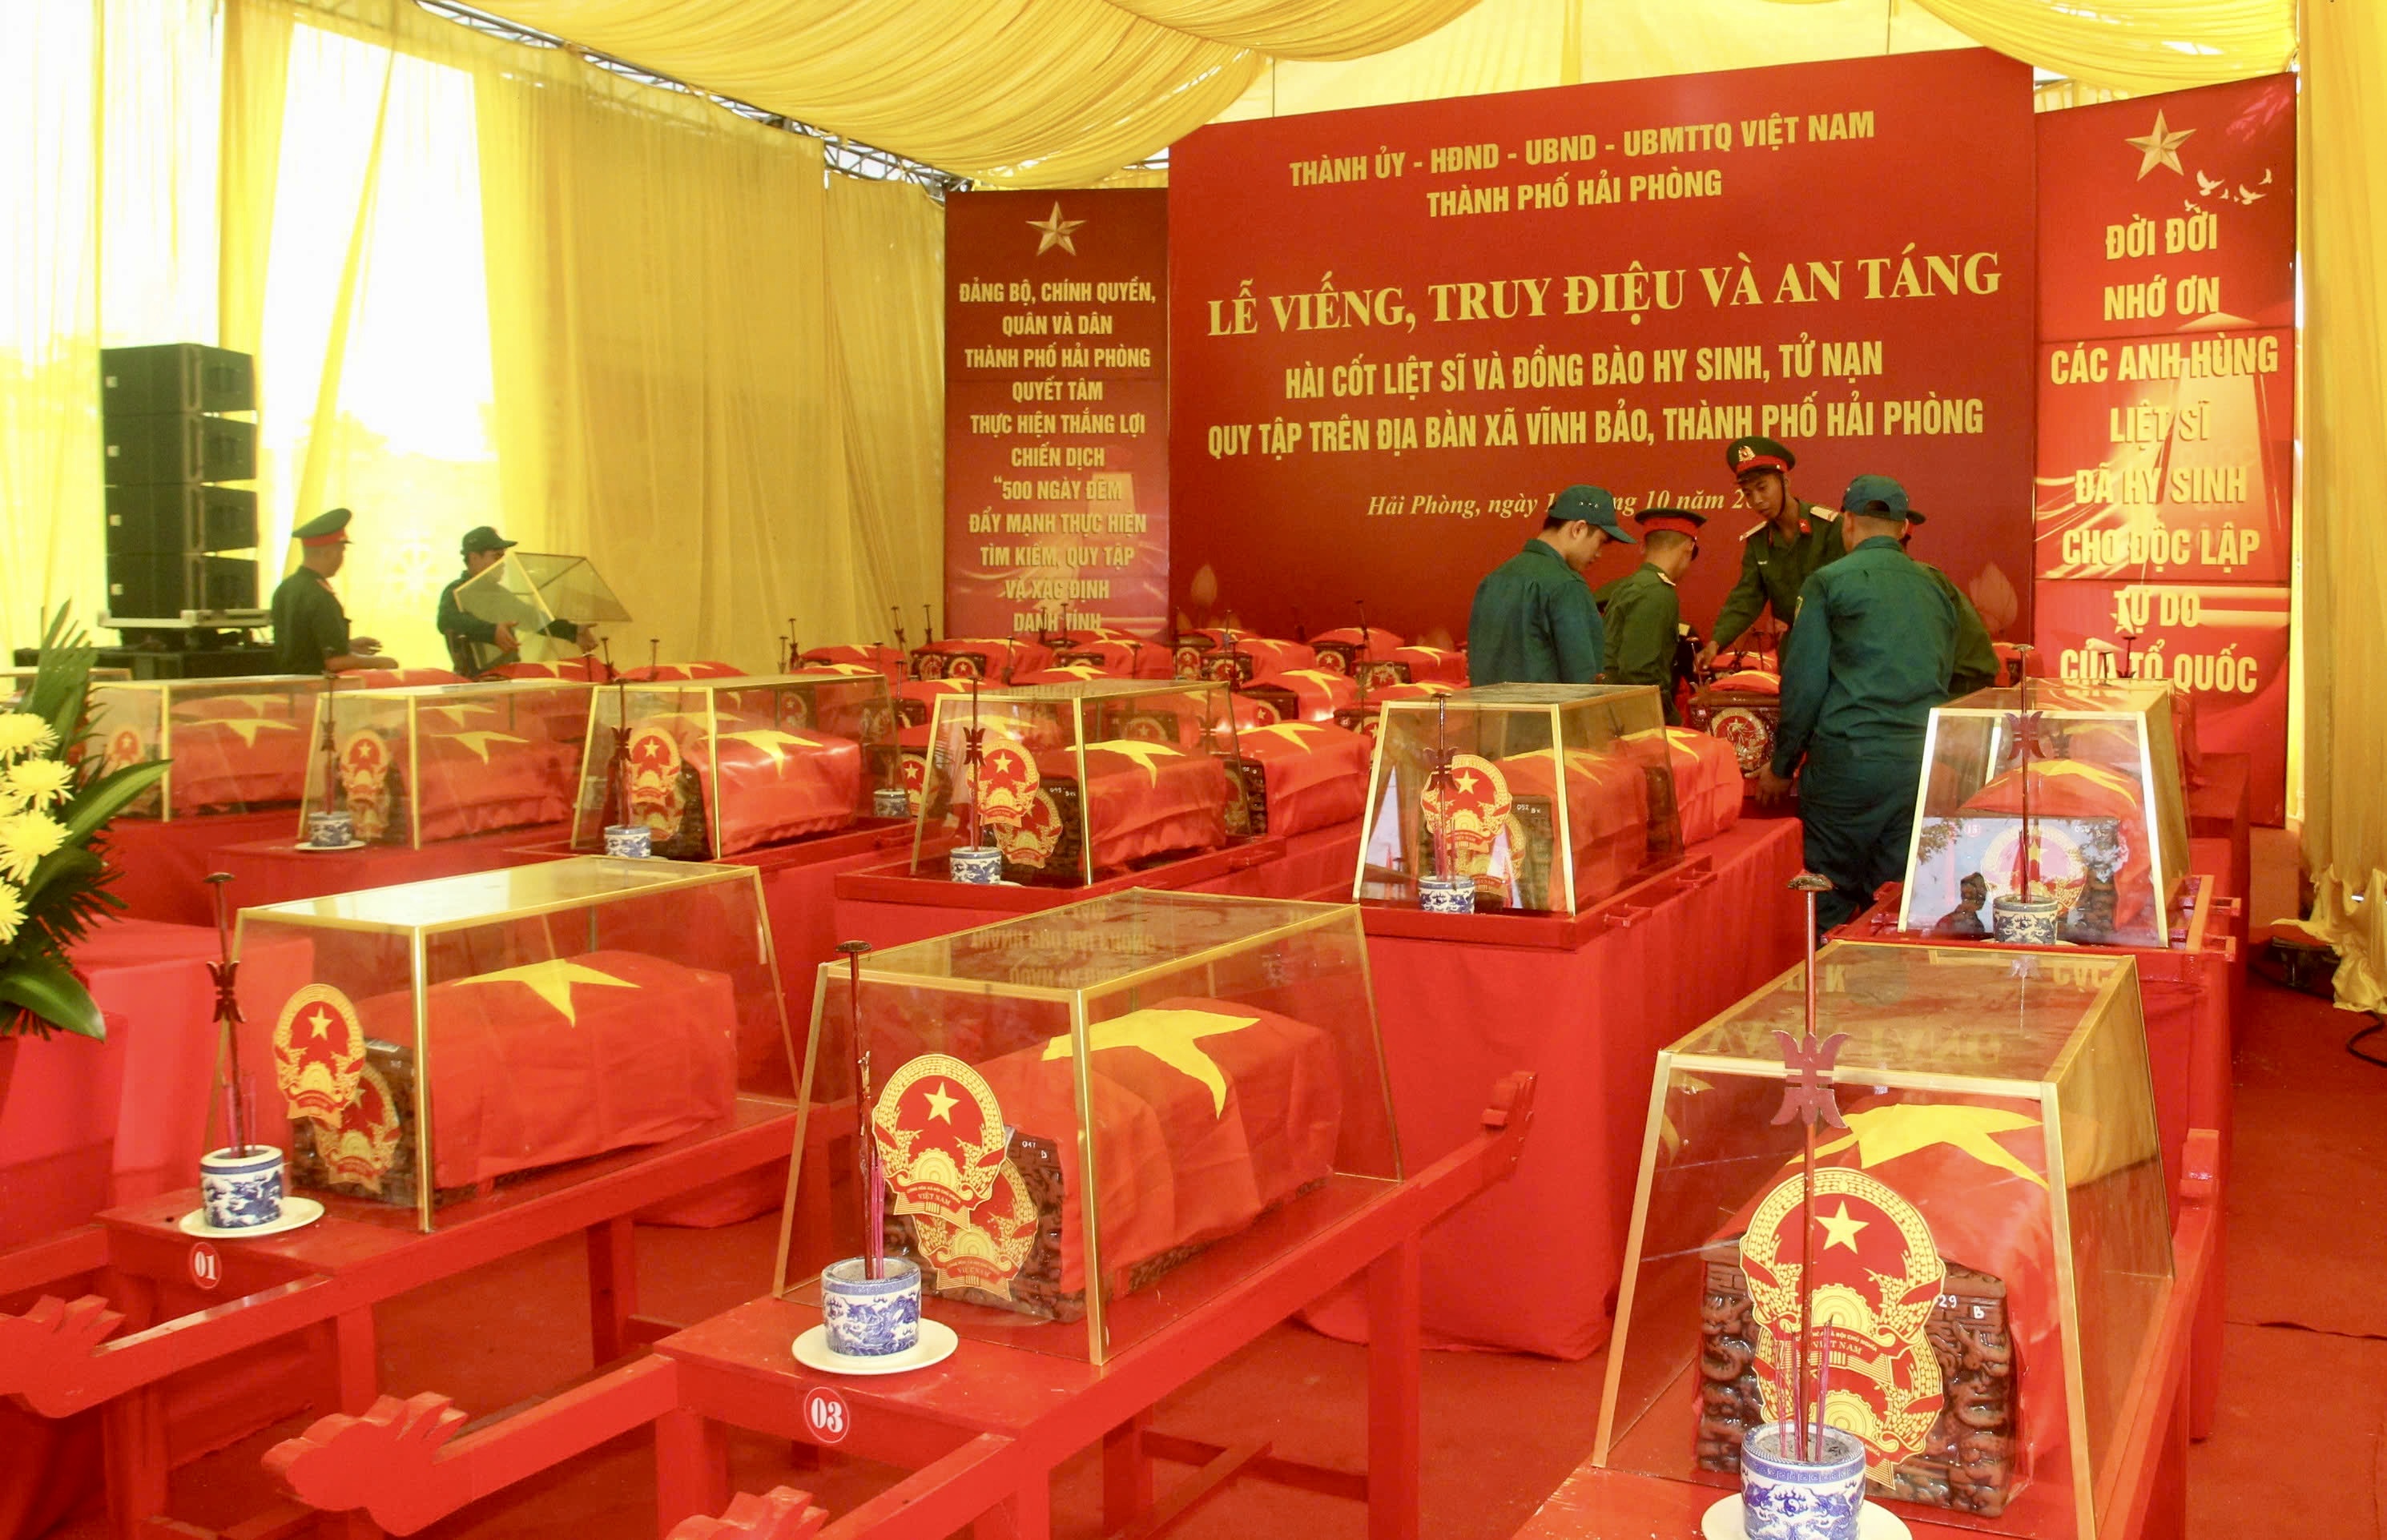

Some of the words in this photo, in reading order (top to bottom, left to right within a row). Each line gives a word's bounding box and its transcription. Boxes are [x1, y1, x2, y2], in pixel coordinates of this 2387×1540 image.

[1290, 155, 1367, 187] THÀNH
[1375, 145, 1406, 179] ỦY
[1431, 143, 1499, 174] HĐND
[1526, 134, 1596, 166] UBND
[1624, 122, 1732, 158] UBMTTQ
[1741, 112, 1799, 151] VIỆT
[1808, 111, 1874, 143] NAM
[1427, 183, 1509, 218] THÀNH
[1517, 171, 1569, 211] PHỐ
[1577, 170, 1621, 206] HẢI
[1629, 166, 1723, 202] PHÒNG
[2106, 213, 2156, 260] ĐỜI
[2165, 206, 2217, 254] ĐỜI
[959, 276, 1004, 303] ĐẢNG
[1009, 279, 1037, 307] BỘ,
[1041, 278, 1092, 302] CHÍNH
[1096, 276, 1156, 305] QUYỀN,
[1207, 277, 1258, 336] LỄ
[1269, 270, 1416, 334] VIẾNG,
[1427, 277, 1552, 323] TRUY
[1564, 260, 1686, 325] ĐIỆU
[1698, 251, 1763, 308] VÀ
[1773, 259, 1844, 304] AN
[1858, 242, 2002, 300] TÁNG
[2104, 274, 2167, 320] NHỚ
[2176, 275, 2220, 315] ƠN
[1002, 312, 1048, 337] QUÂN
[1052, 312, 1073, 335] VÀ
[1078, 312, 1113, 335] DÂN
[964, 344, 1019, 368] THÀNH
[1023, 341, 1057, 368] PHỐ
[1061, 342, 1089, 368] HẢI
[1094, 344, 1151, 368] PHÒNG
[1286, 360, 1324, 400] HÀI
[1332, 352, 1378, 396] CỐT
[1384, 355, 1433, 400] LIỆT
[1440, 352, 1466, 392] SĨ
[1473, 350, 1505, 391] VÀ
[1512, 344, 1583, 389] ĐỒNG
[1592, 344, 1644, 386] BÀO
[1653, 348, 1688, 383] HY
[1696, 345, 1770, 384] SINH,
[1778, 332, 1816, 378] TỬ
[1822, 340, 1883, 384] NẠN
[2051, 342, 2108, 385] CÁC
[2117, 343, 2180, 382] ANH
[2190, 332, 2279, 378] HÙNG
[1012, 375, 1063, 403] QUYẾT
[1067, 377, 1103, 400] TÂM
[970, 412, 1012, 438] THỰC
[1017, 410, 1057, 438] HIỆN
[1061, 407, 1115, 434] THẮNG
[1120, 412, 1145, 437] LỢI
[1208, 424, 1252, 460] QUY
[1259, 416, 1302, 461] TẬP
[1310, 414, 1370, 452] TRÊN
[1377, 418, 1418, 457] ĐỊA
[1426, 409, 1477, 448] BÀN
[1484, 407, 1519, 447] XÃ
[1526, 406, 1586, 445] VĨNH
[1595, 398, 1655, 446] BẢO,
[1663, 399, 1753, 441] THÀNH
[1762, 390, 1818, 438] PHỐ
[1826, 390, 1874, 436] HẢI
[1884, 391, 1983, 436] PHÒNG
[2110, 399, 2171, 451] LIỆT
[2179, 400, 2210, 441] SĨ
[1011, 442, 1061, 467] CHIẾN
[1066, 447, 1105, 471] DỊCH
[1037, 476, 1081, 500] NGÀY
[1085, 477, 1122, 500] ĐÊM
[2075, 461, 2114, 504] ĐÃ
[2123, 467, 2162, 505] HY
[2171, 467, 2248, 505] SINH
[968, 505, 1002, 533] ĐẨY
[1006, 513, 1057, 537] MẠNH
[1061, 513, 1103, 537] THỰC
[1108, 512, 1147, 537] HIỆN
[1367, 495, 1405, 516] Hải
[1410, 494, 1480, 519] Phòng,
[1487, 493, 1539, 519] ngày
[1646, 489, 1671, 509] 10
[1676, 489, 1725, 509] năm
[980, 543, 1010, 566] TÌM
[1065, 546, 1099, 569] QUY
[1104, 542, 1135, 571] TẬP
[2062, 529, 2119, 565] CHO
[2127, 521, 2191, 573] ĐỘC
[2200, 521, 2260, 573] LẬP
[1069, 579, 1109, 603] ĐỊNH
[1013, 612, 1058, 632] DANH
[1066, 609, 1101, 630] TÍNH
[2114, 590, 2152, 633] TỰ
[2160, 592, 2200, 627] DO
[2128, 638, 2166, 681] TỔ
[2173, 643, 2258, 694] QUỐC
[195, 1251, 216, 1280] 01
[1813, 1340, 1838, 1349] VIT
[1839, 1341, 1862, 1355] NAM
[811, 1397, 843, 1433] 03
